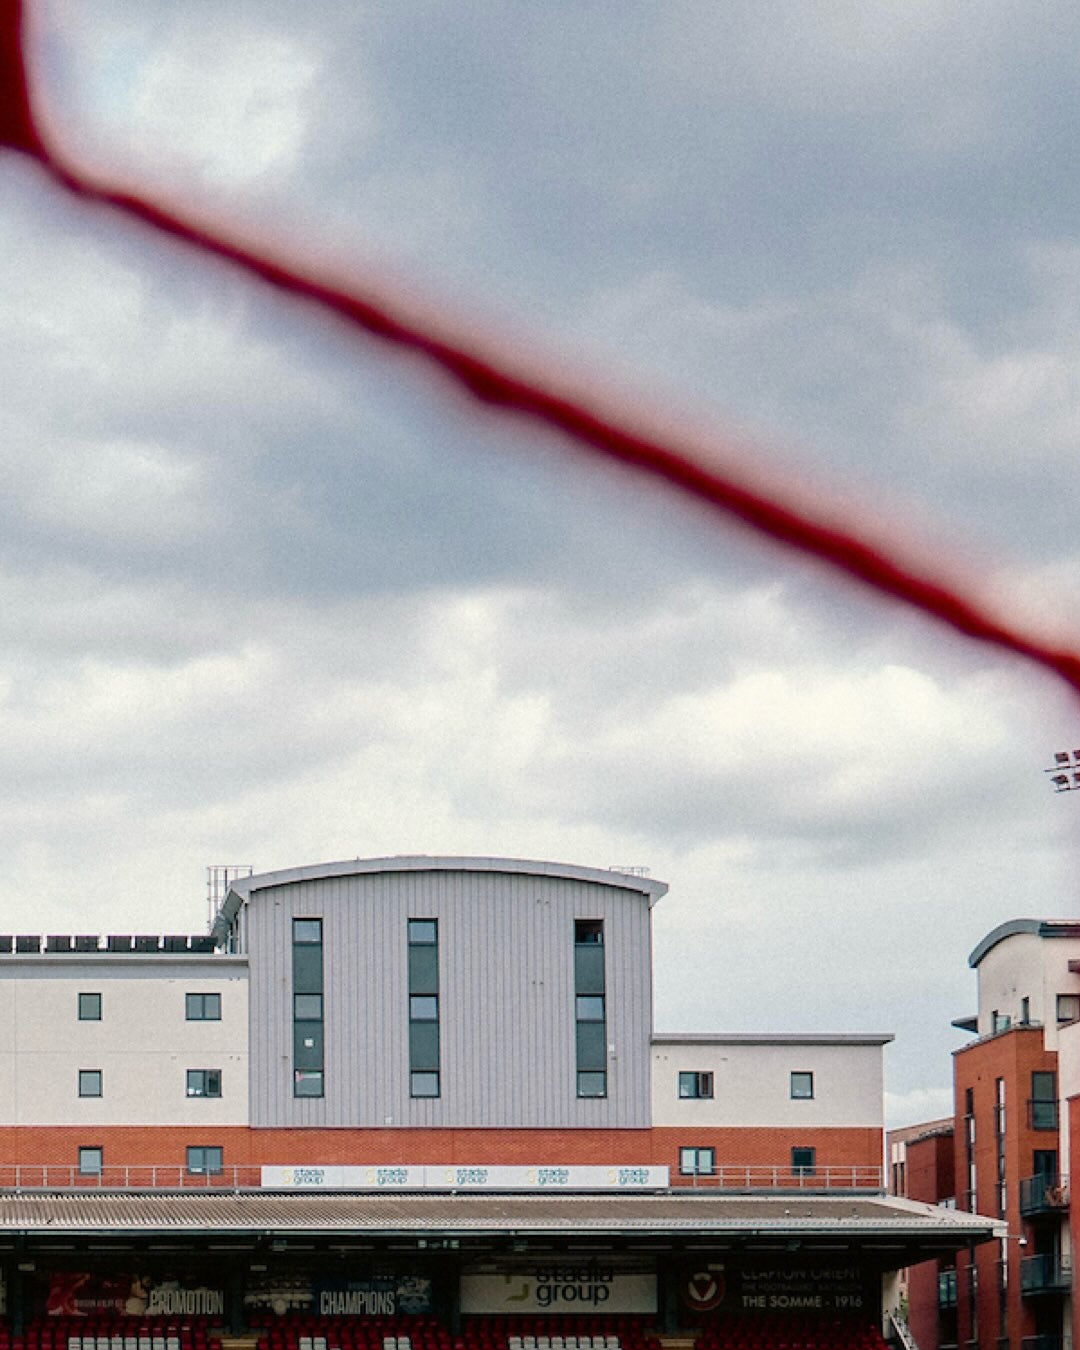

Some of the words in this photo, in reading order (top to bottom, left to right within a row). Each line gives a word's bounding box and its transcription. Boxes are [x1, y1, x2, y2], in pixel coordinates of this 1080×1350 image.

[320, 1291, 395, 1315] CHAMPIONS
[536, 1285, 610, 1307] group
[742, 1295, 766, 1307] THE
[769, 1295, 822, 1307] SOMME
[834, 1295, 864, 1307] 1916
